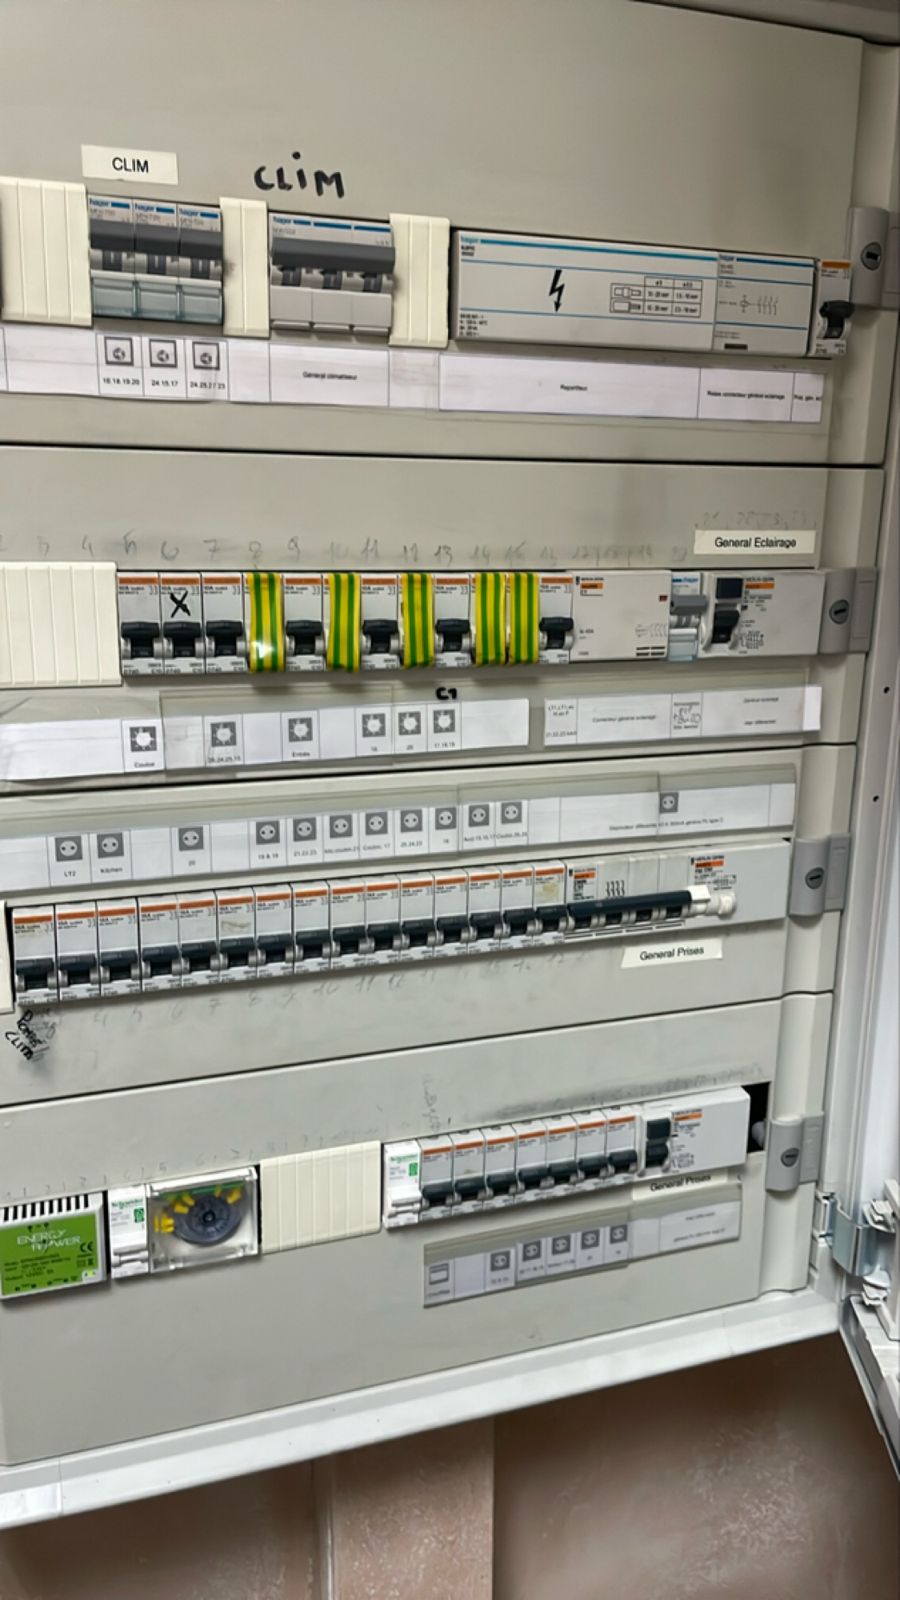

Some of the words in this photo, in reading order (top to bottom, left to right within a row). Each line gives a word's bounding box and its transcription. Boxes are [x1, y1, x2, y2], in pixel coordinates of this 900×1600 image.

[112, 156, 150, 174] CLIM
[714, 537, 752, 548] General
[754, 536, 797, 549] Eclairage
[436, 687, 457, 700] C1
[639, 947, 676, 961] General
[677, 946, 705, 957] Prises
[650, 1176, 685, 1192] General
[17, 1229, 66, 1245] ENERGY
